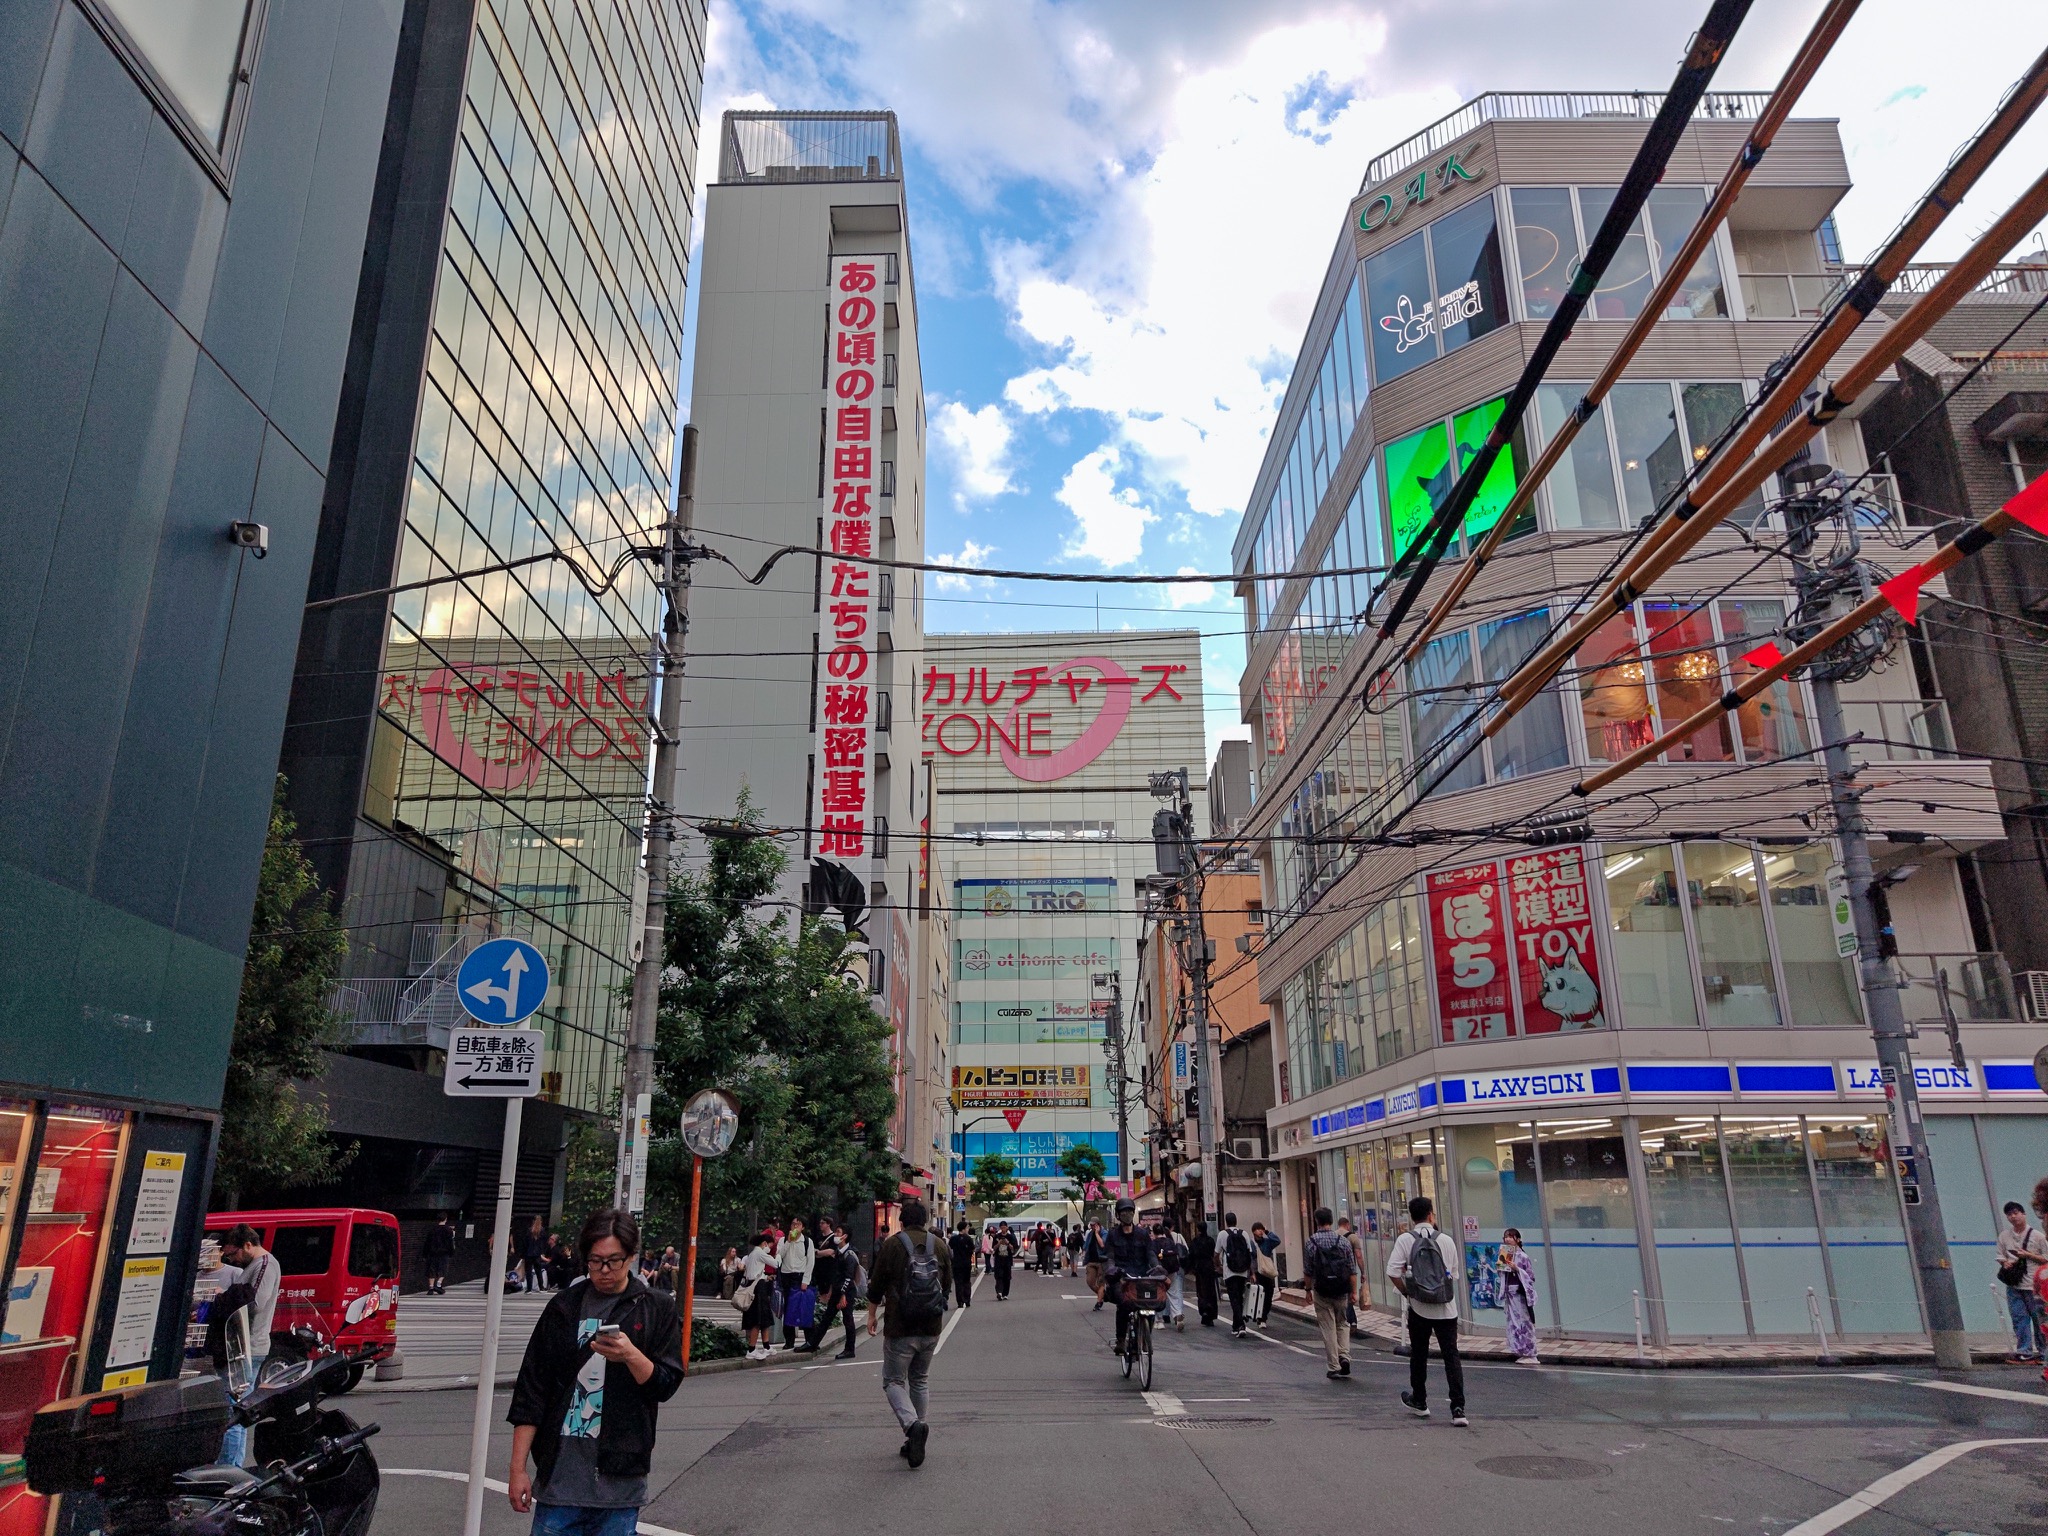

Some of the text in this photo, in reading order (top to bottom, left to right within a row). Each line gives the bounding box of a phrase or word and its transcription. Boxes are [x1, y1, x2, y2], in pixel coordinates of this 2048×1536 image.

[1359, 141, 1487, 233] OAK
[1402, 289, 1483, 349] Guild
[818, 262, 876, 858] あの頃の自由な僕たちの秘密基地
[923, 664, 1187, 705] カルチャーズ
[1434, 864, 1491, 886] ホビーランド
[1511, 849, 1584, 893] 鉄道
[1027, 890, 1085, 910] TRIO
[1516, 886, 1590, 930] 模型
[1442, 884, 1496, 988] ぽち
[1518, 924, 1592, 961] TOY
[997, 952, 1107, 966] at home cafe
[1450, 995, 1504, 1011] 秋葉原1号店
[1466, 1016, 1492, 1039] 2F
[456, 1035, 536, 1054] 自転車を除く
[454, 1055, 535, 1074] 一方通行
[1471, 1071, 1586, 1100] LAWSON
[1847, 1068, 1973, 1089] LASON
[1387, 1090, 1417, 1115] LAWSON
[155, 1157, 171, 1168] ご案内
[128, 1264, 160, 1274] Information
[286, 1289, 316, 1298] 日本郵便
